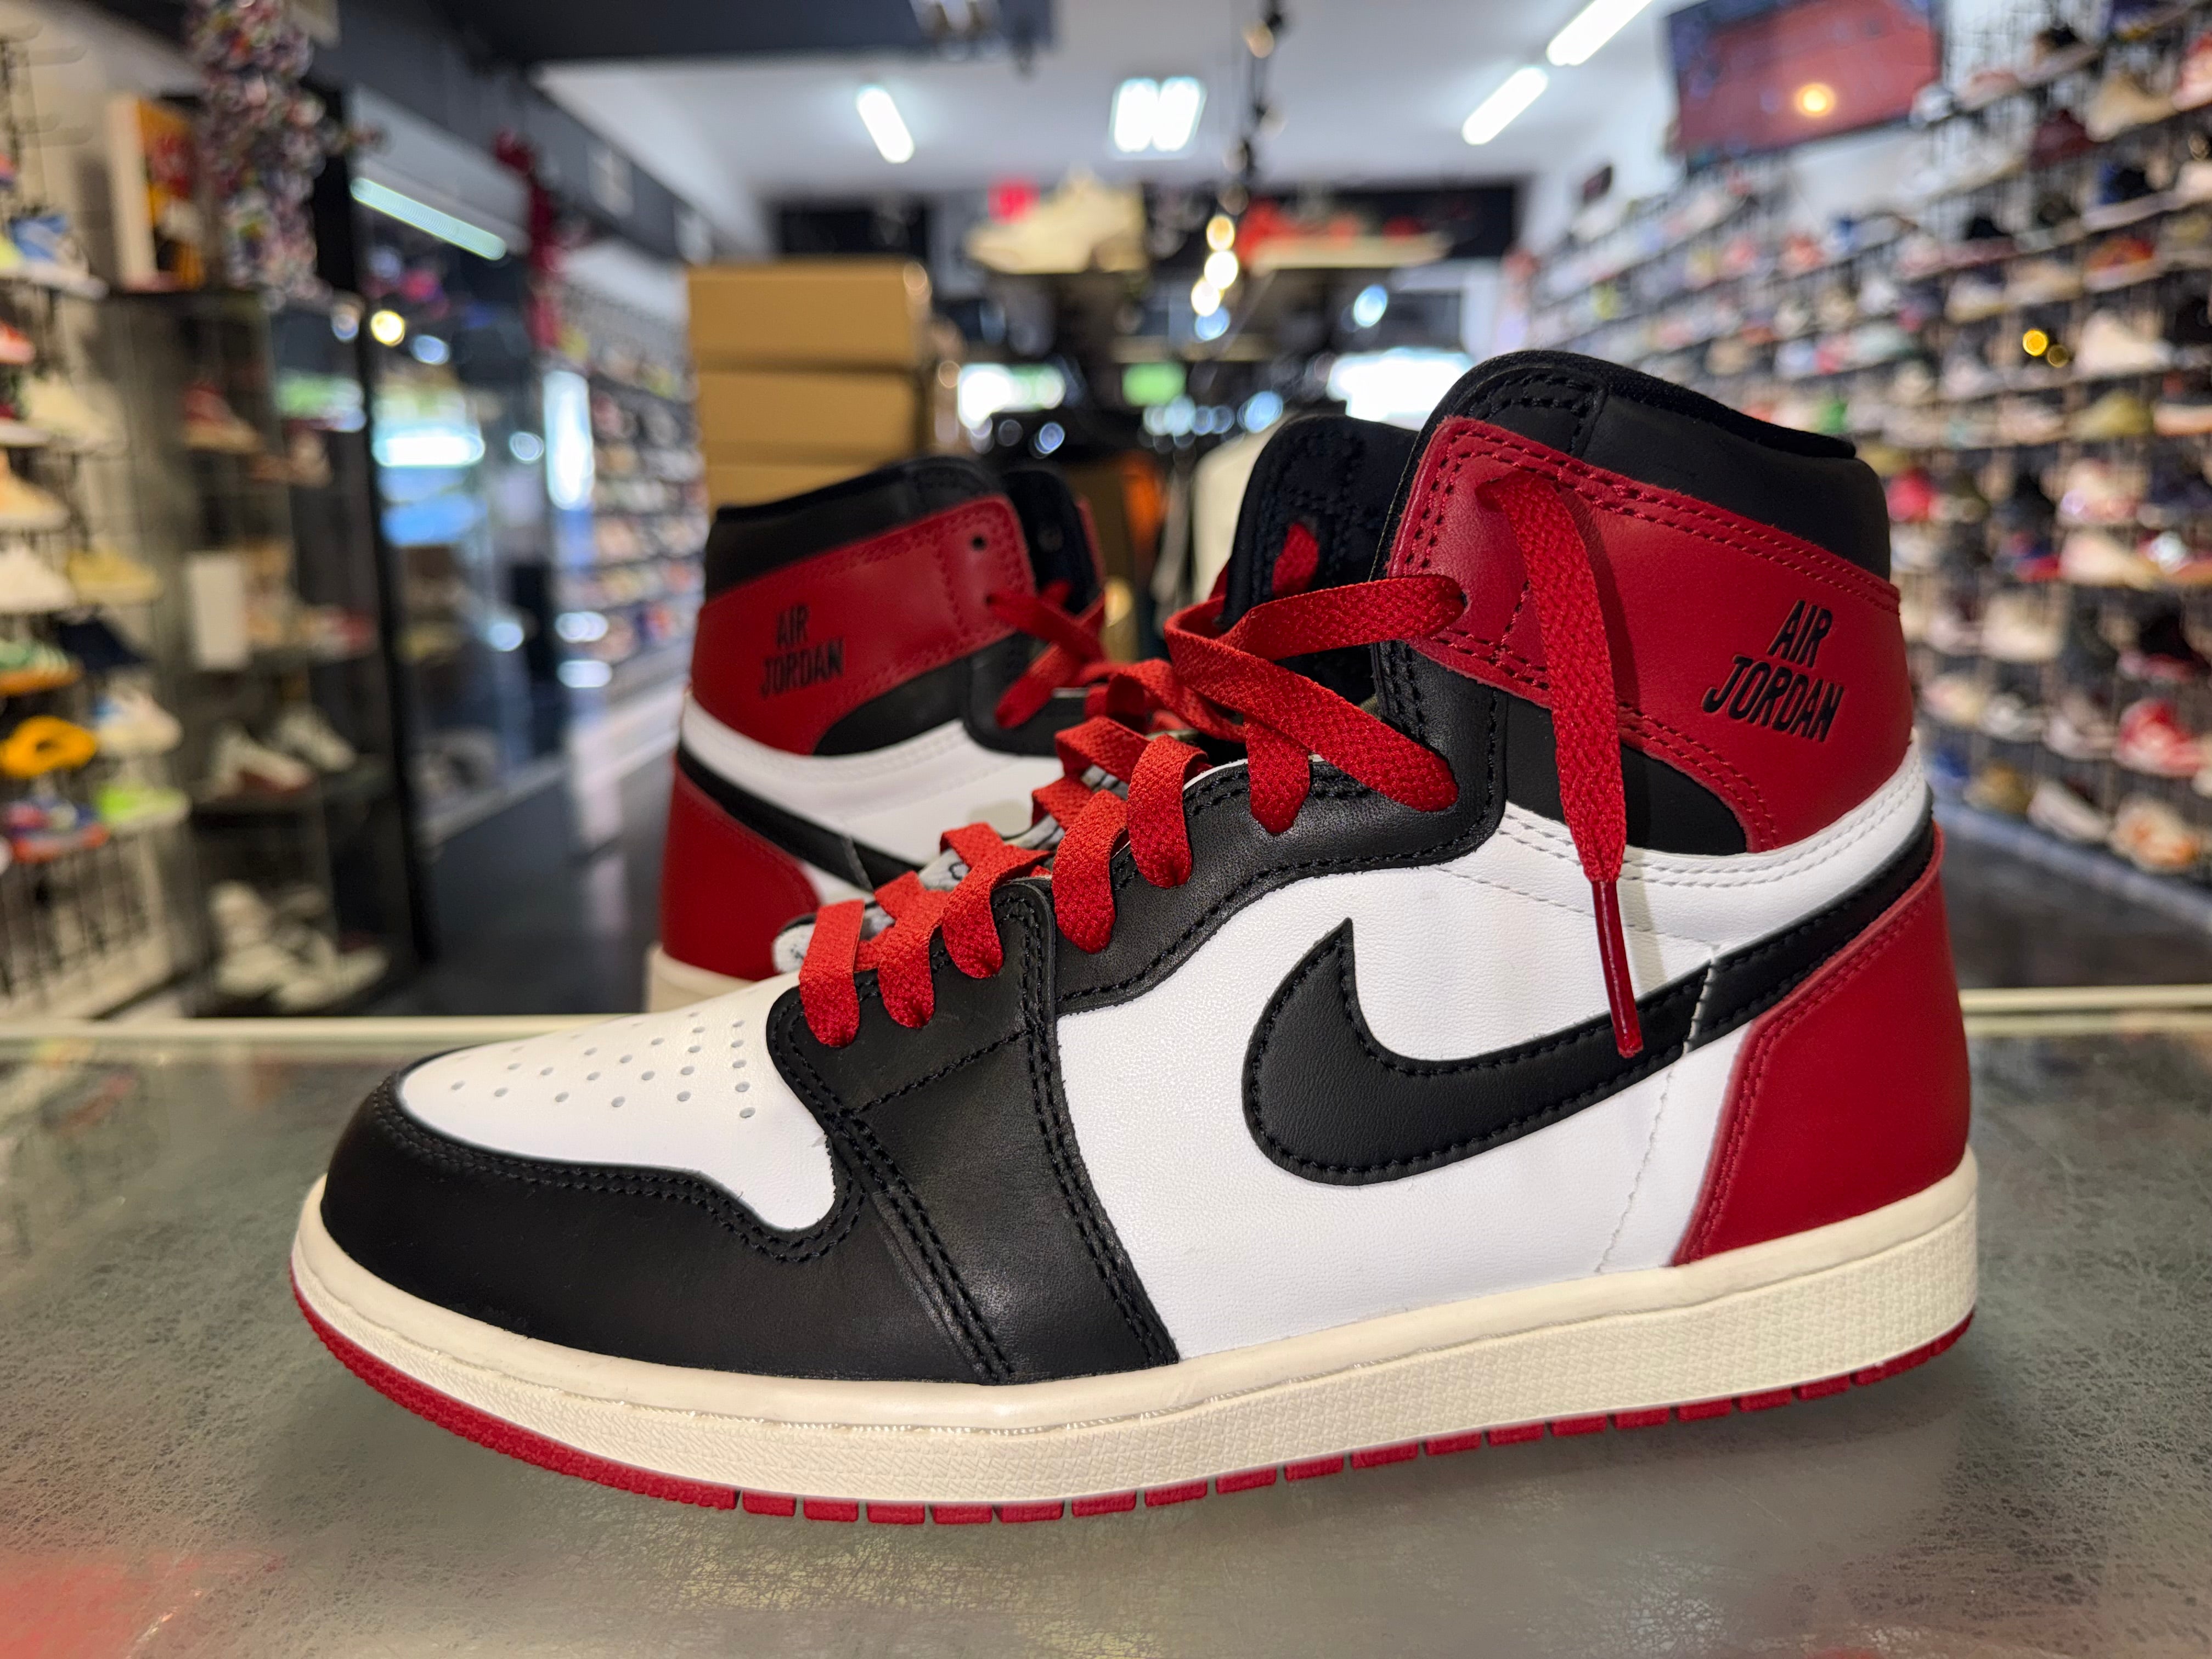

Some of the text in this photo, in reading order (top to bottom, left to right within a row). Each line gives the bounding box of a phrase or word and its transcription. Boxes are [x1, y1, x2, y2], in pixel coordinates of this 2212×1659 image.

[776, 604, 809, 647] AIR
[1767, 600, 1833, 668] AIR
[759, 637, 843, 698] JORDAN
[1702, 654, 1844, 742] JORDAN
